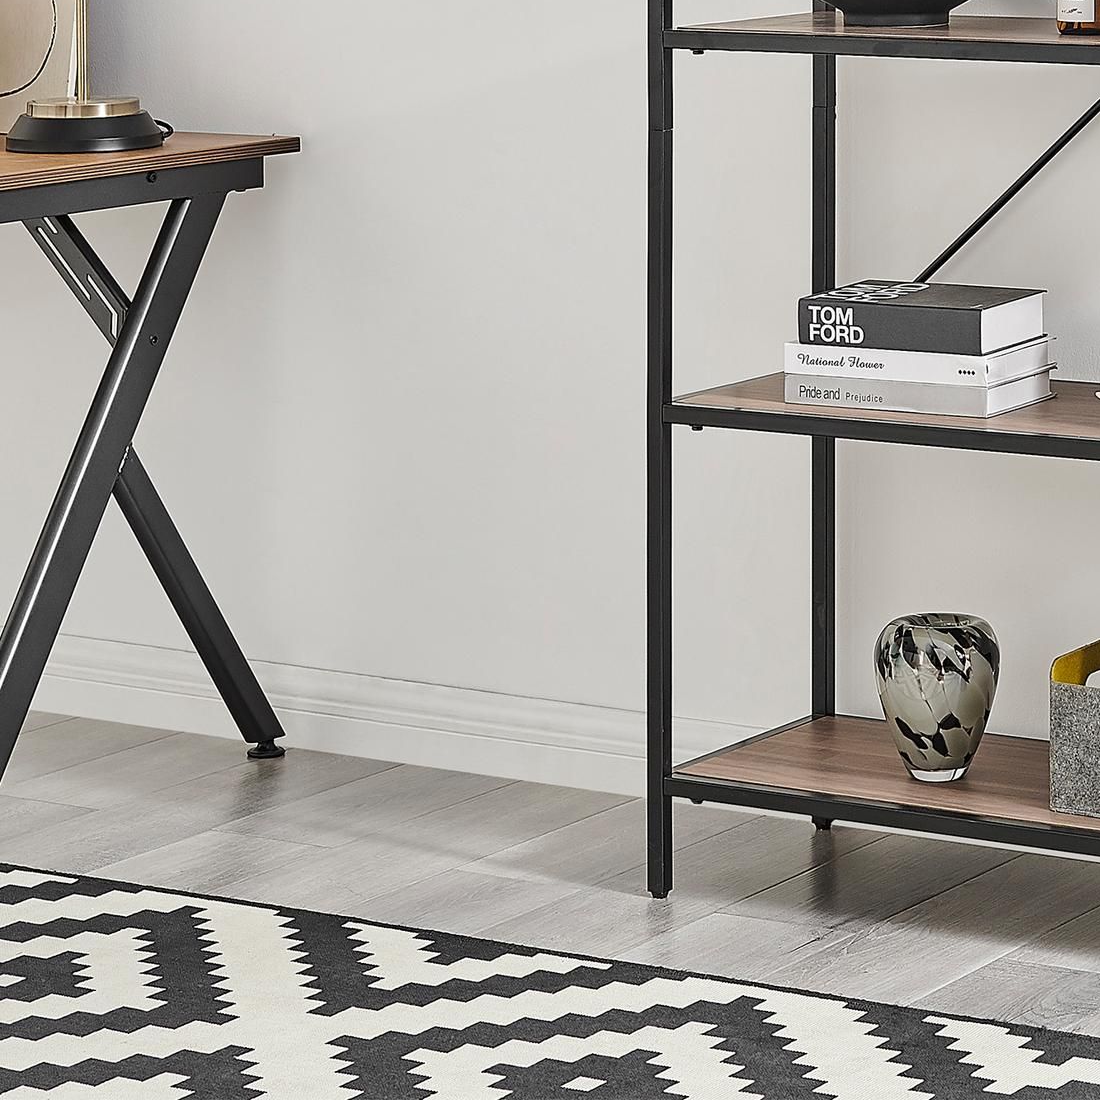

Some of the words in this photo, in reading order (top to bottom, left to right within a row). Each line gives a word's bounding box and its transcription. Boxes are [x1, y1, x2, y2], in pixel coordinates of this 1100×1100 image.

[808, 306, 854, 326] TOM
[809, 324, 864, 344] FORD
[797, 353, 845, 367] National
[848, 356, 884, 370] Flower
[799, 385, 822, 398] Pride
[823, 388, 840, 400] and
[846, 392, 883, 403] Prejudice
